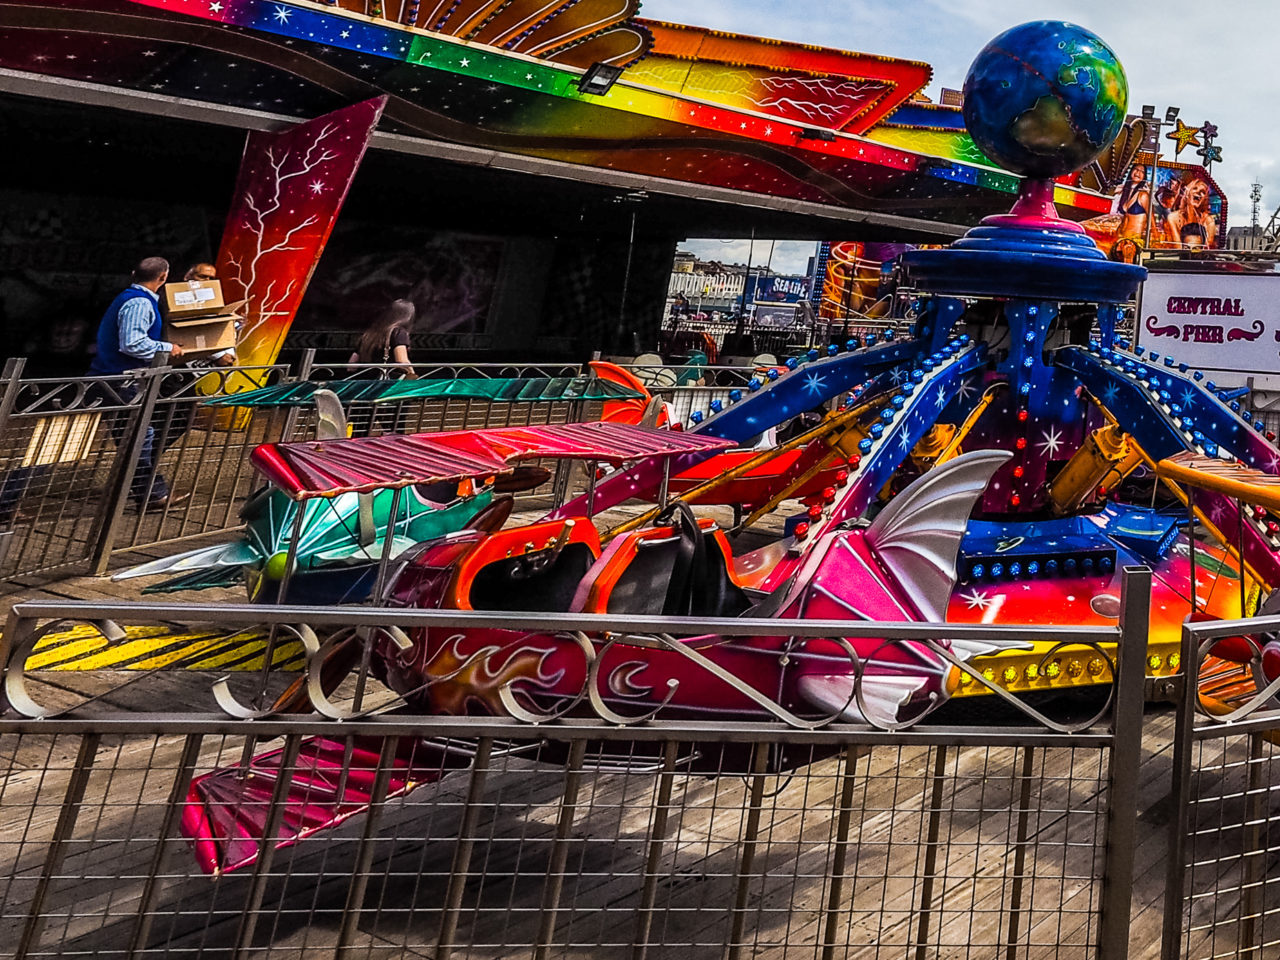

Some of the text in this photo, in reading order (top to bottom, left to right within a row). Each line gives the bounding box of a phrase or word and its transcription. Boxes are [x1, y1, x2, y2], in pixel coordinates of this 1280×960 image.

[773, 278, 789, 293] SEA
[1167, 297, 1244, 316] CENTRAL
[1182, 325, 1224, 343] PIER
